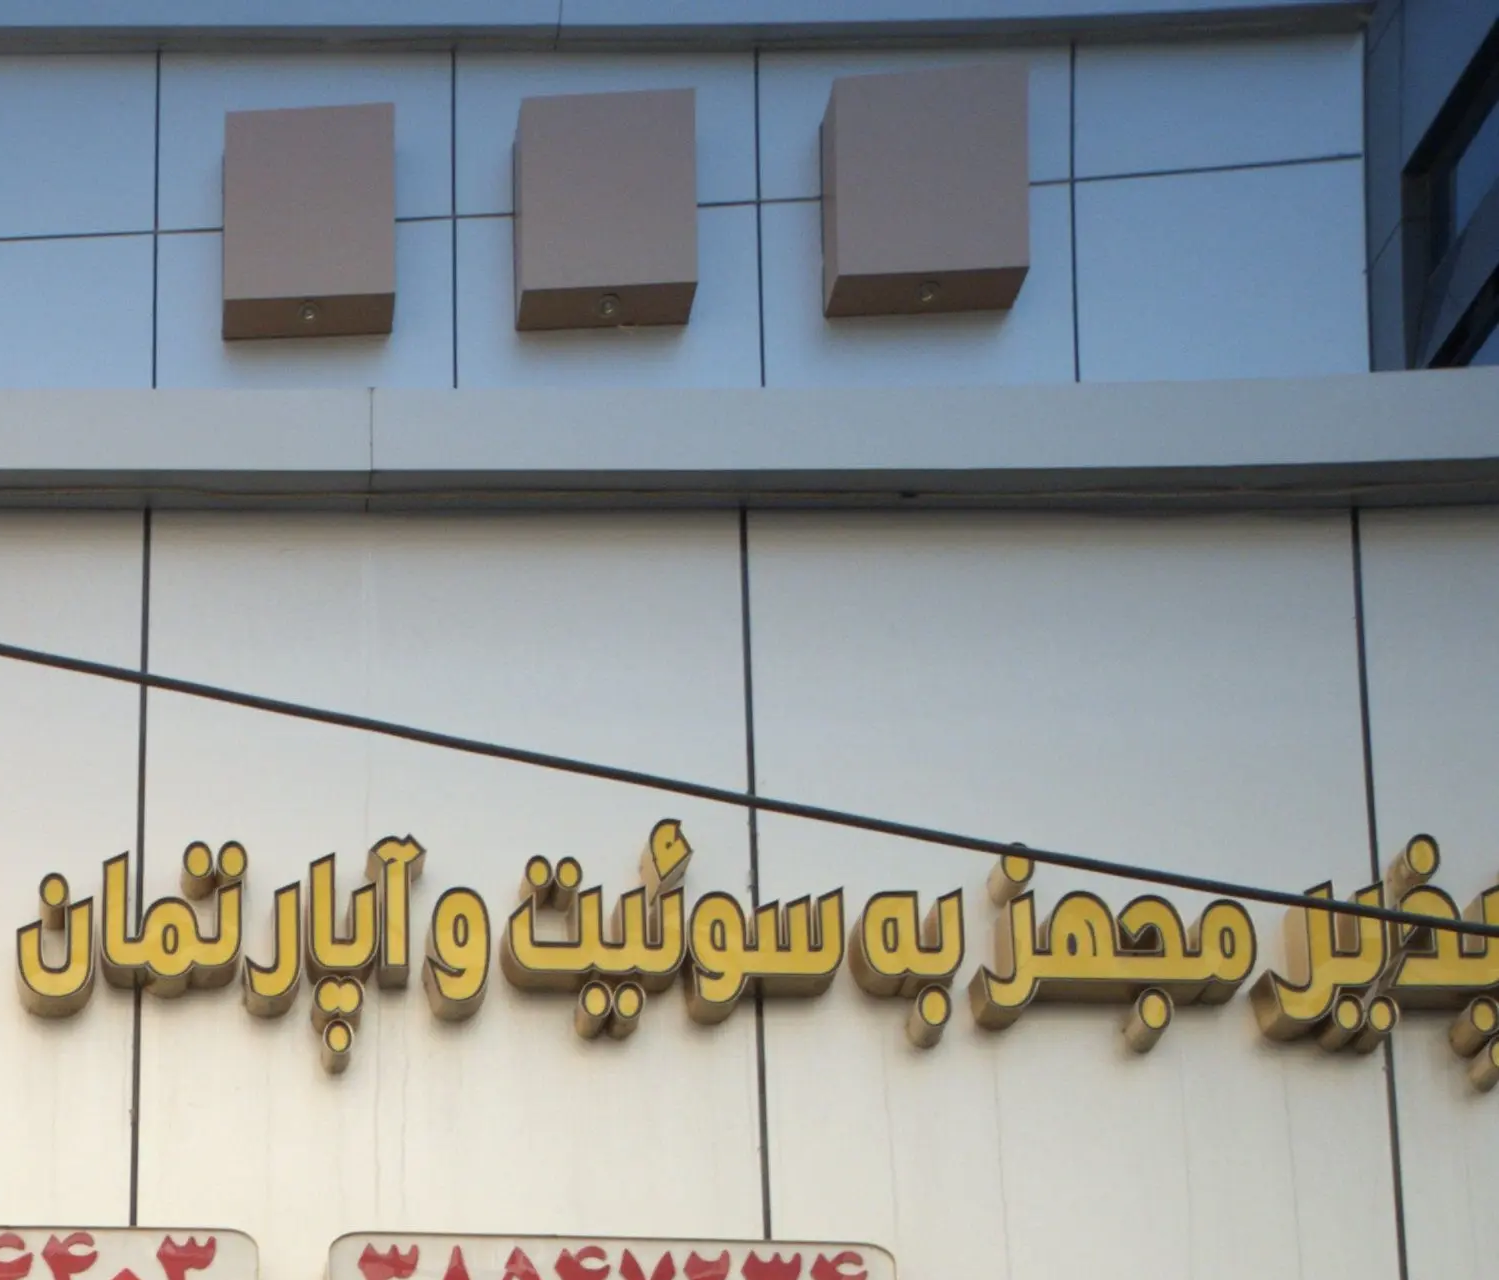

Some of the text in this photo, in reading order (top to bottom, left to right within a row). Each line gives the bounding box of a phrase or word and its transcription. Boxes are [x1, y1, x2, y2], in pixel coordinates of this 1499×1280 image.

[16, 833, 426, 1073] آپارتمان
[424, 886, 492, 1021] و
[501, 818, 845, 1039] سوئیت
[847, 886, 965, 1048] به
[969, 841, 1257, 1053] مجهز
